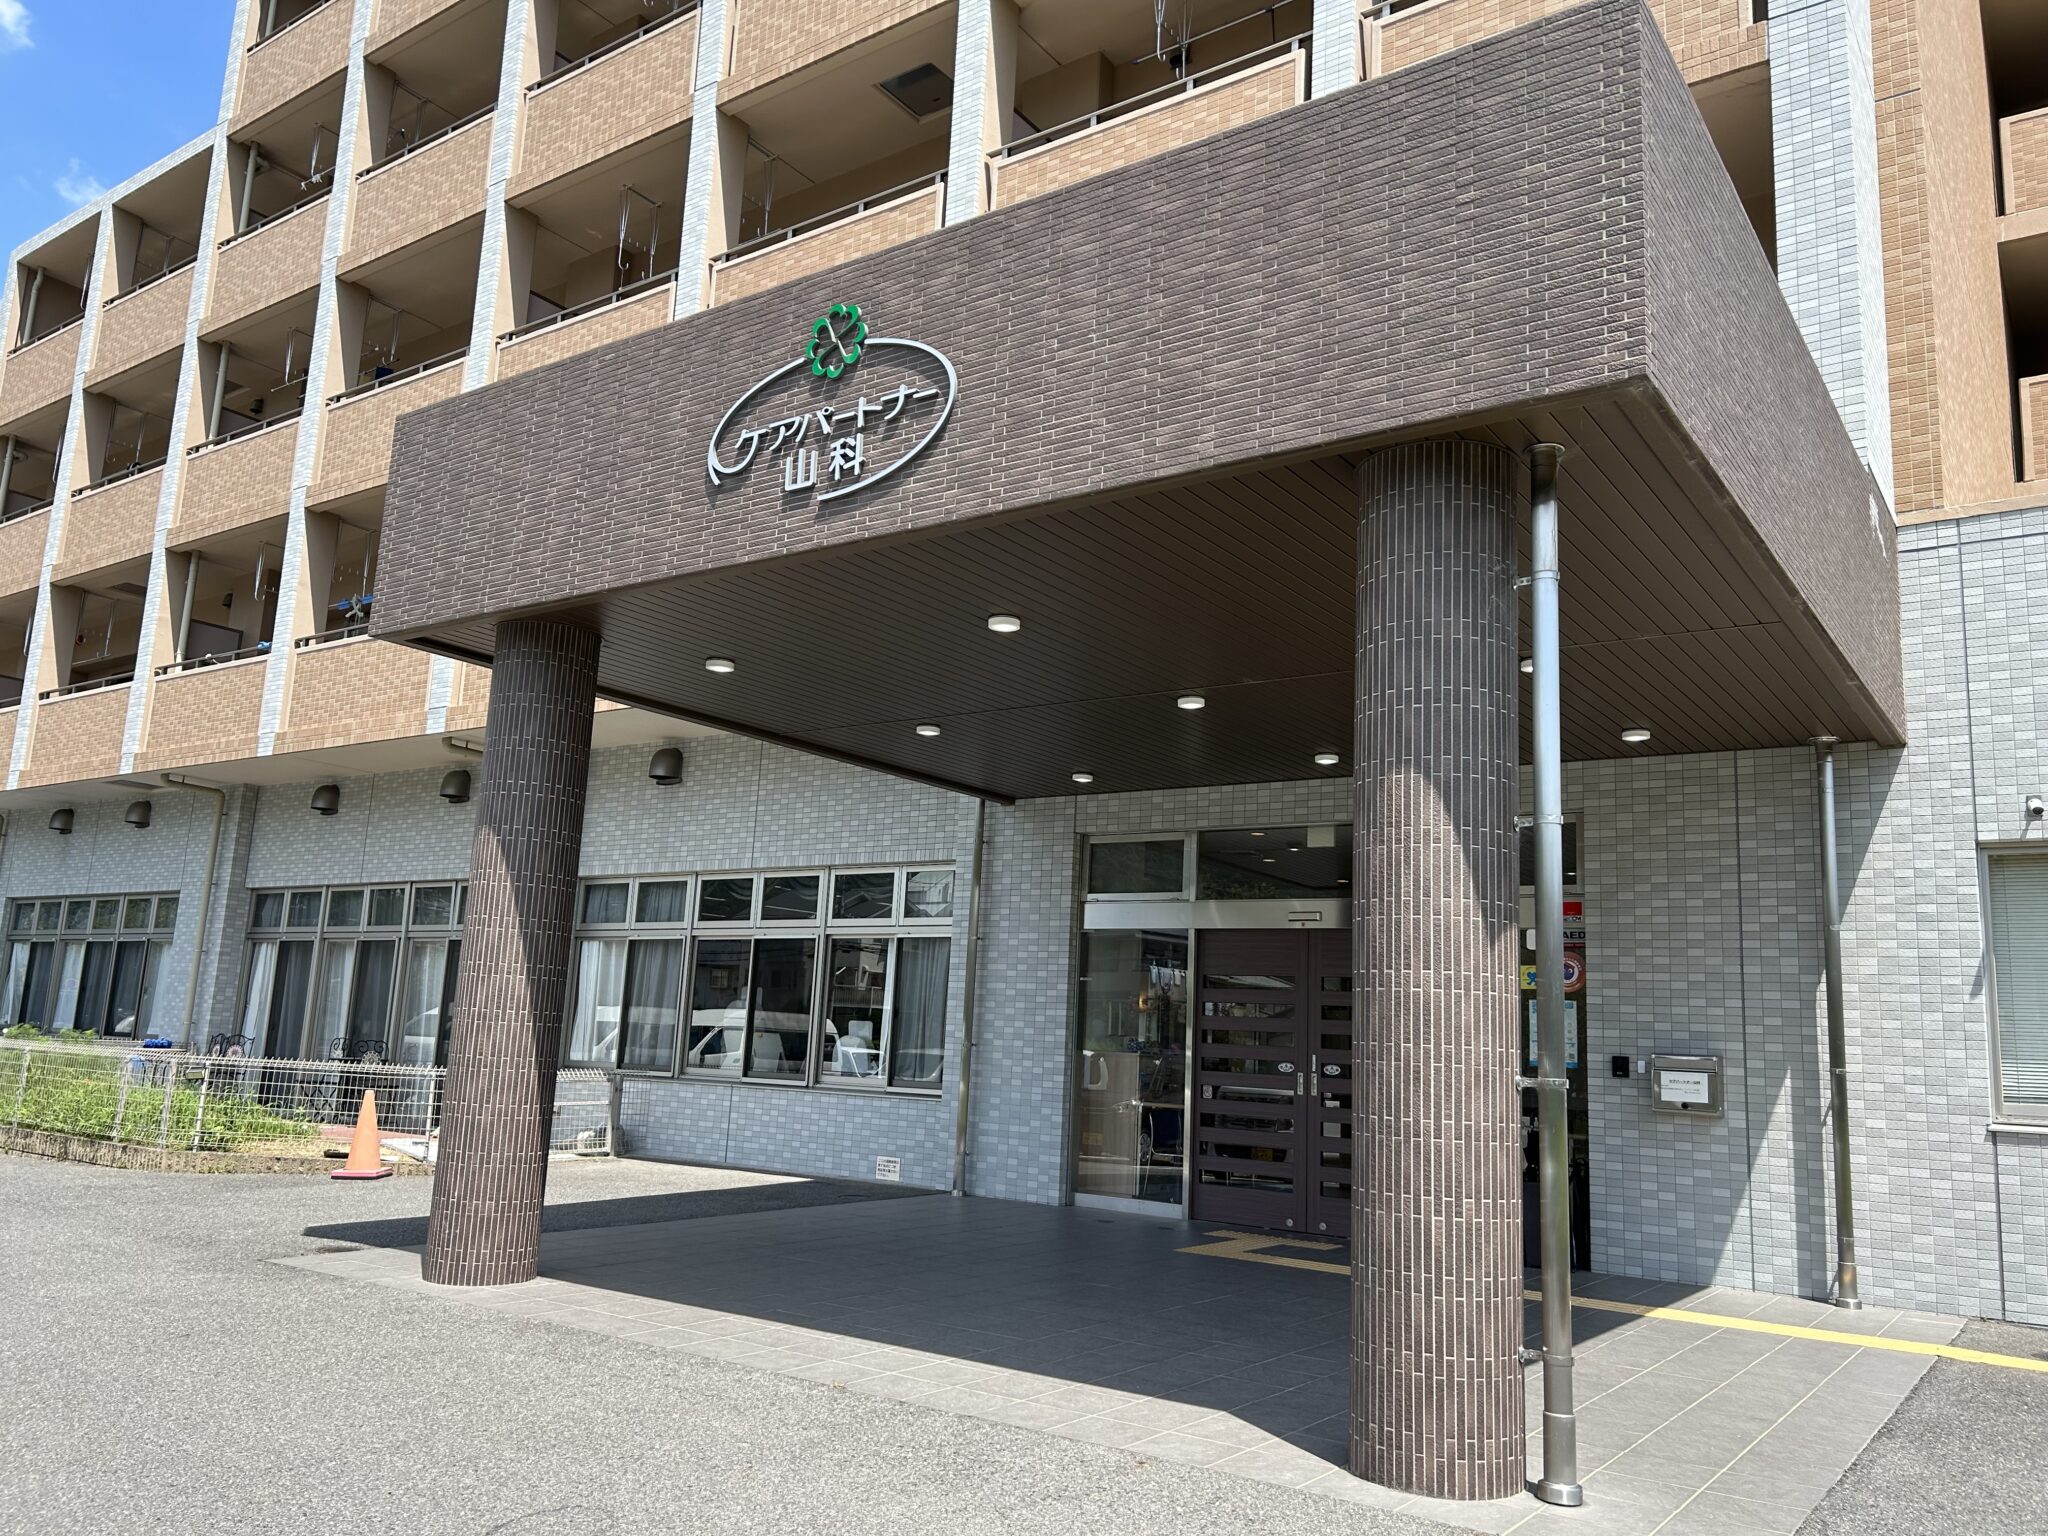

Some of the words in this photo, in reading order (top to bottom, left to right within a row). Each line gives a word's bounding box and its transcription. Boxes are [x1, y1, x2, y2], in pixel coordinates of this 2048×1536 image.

[733, 383, 941, 460] ケアパートナー
[784, 432, 867, 492] 山科
[1563, 931, 1585, 939] AED
